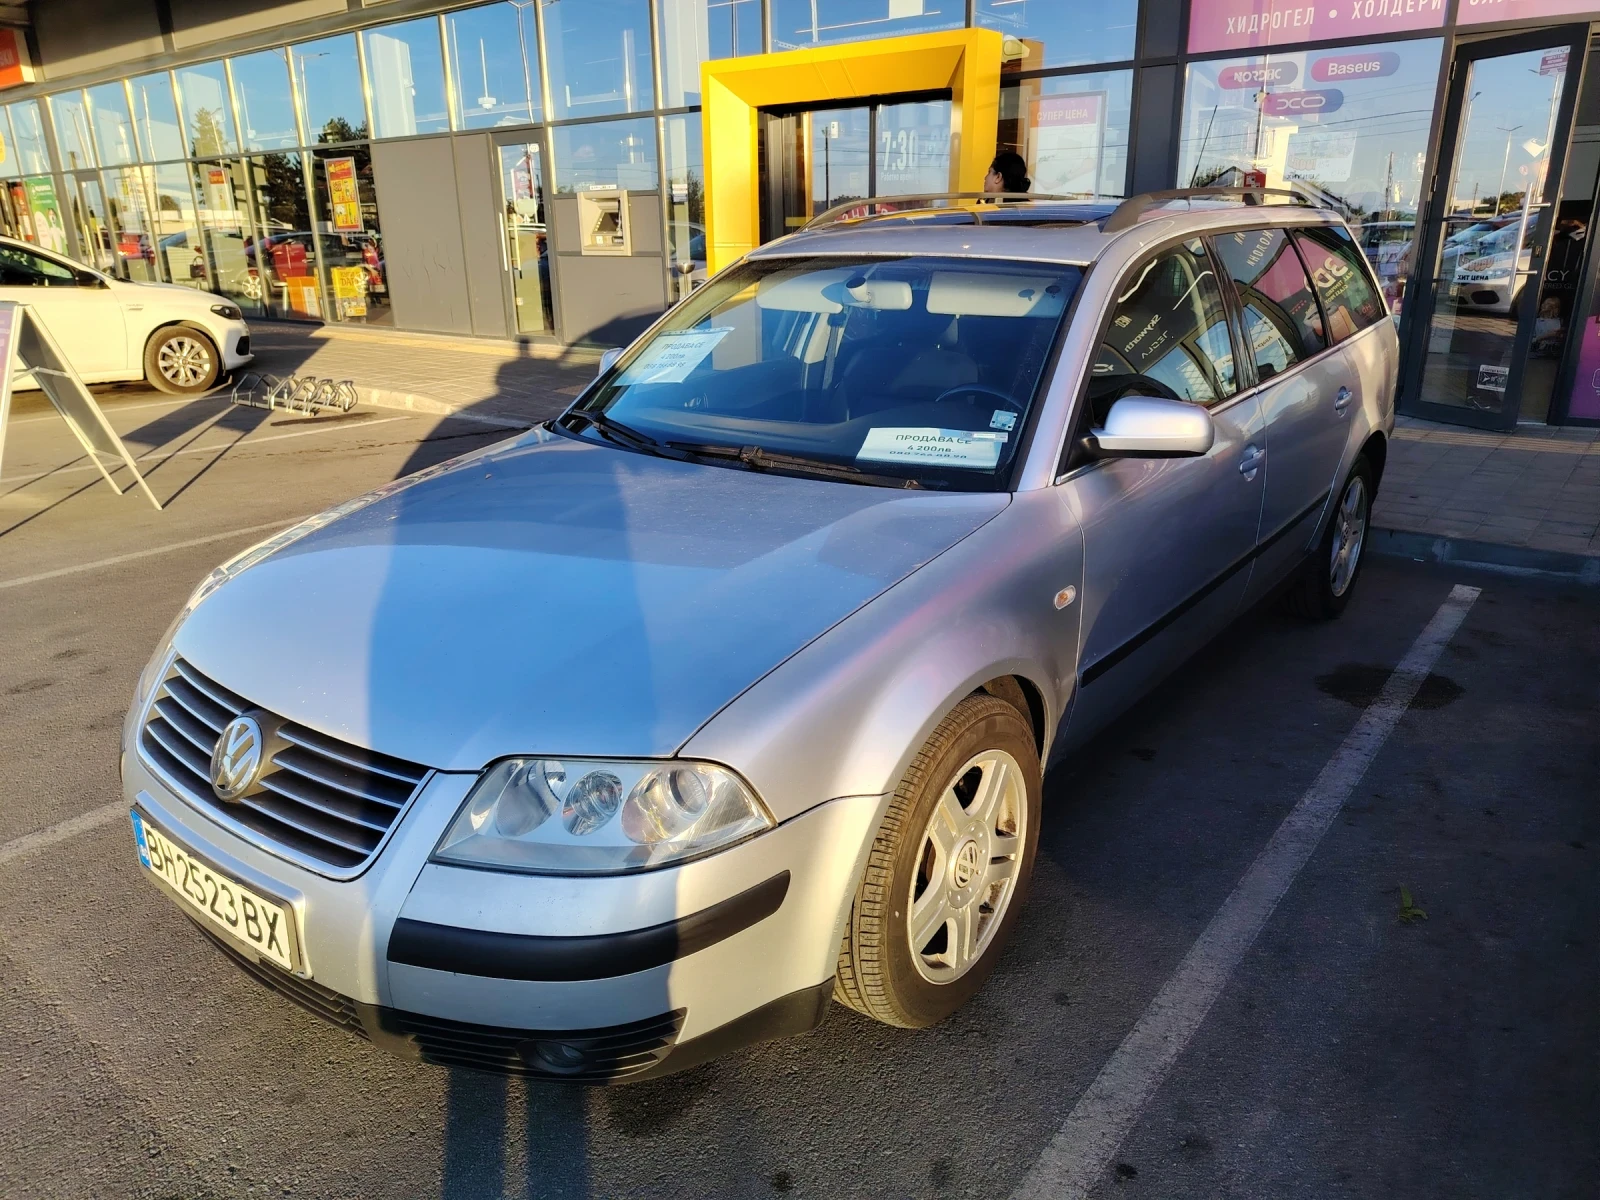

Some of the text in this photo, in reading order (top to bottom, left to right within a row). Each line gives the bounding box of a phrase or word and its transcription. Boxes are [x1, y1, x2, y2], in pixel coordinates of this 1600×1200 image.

[1226, 0, 1443, 35] ХИДРОГЕЛ ХОЛДЕРИ
[1328, 61, 1381, 76] Baseus
[1036, 108, 1089, 122] СУПЕР ЦЕНА
[881, 130, 919, 171] 7:30
[1471, 274, 1489, 282] ЦЕНА
[895, 434, 953, 443] ПРОДАВА
